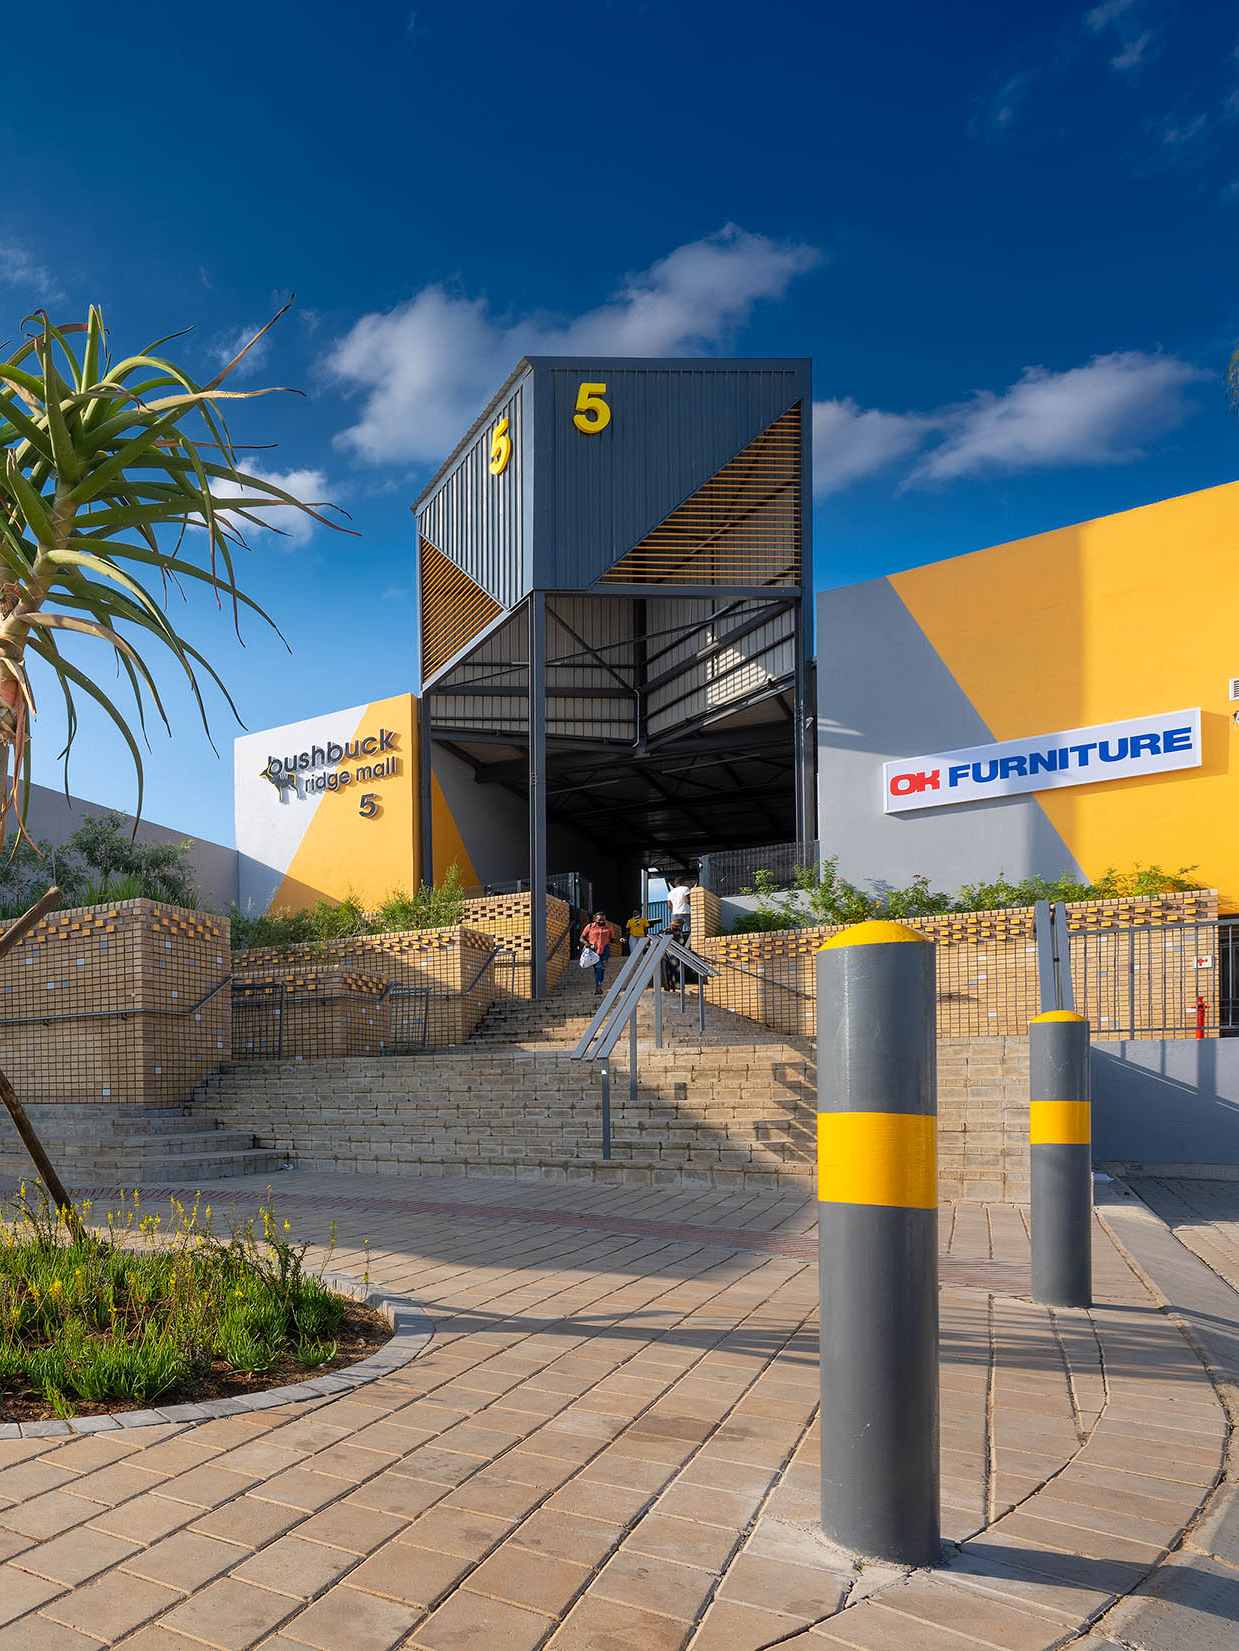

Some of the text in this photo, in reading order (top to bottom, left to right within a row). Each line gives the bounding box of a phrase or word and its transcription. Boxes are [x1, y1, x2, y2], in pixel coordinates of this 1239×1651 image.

[573, 382, 611, 434] 5
[489, 418, 511, 475] 5
[267, 728, 395, 775] bushbuck
[305, 756, 397, 793] ridge mall
[889, 727, 1193, 796] OK FURNITURE
[359, 793, 377, 817] 5
